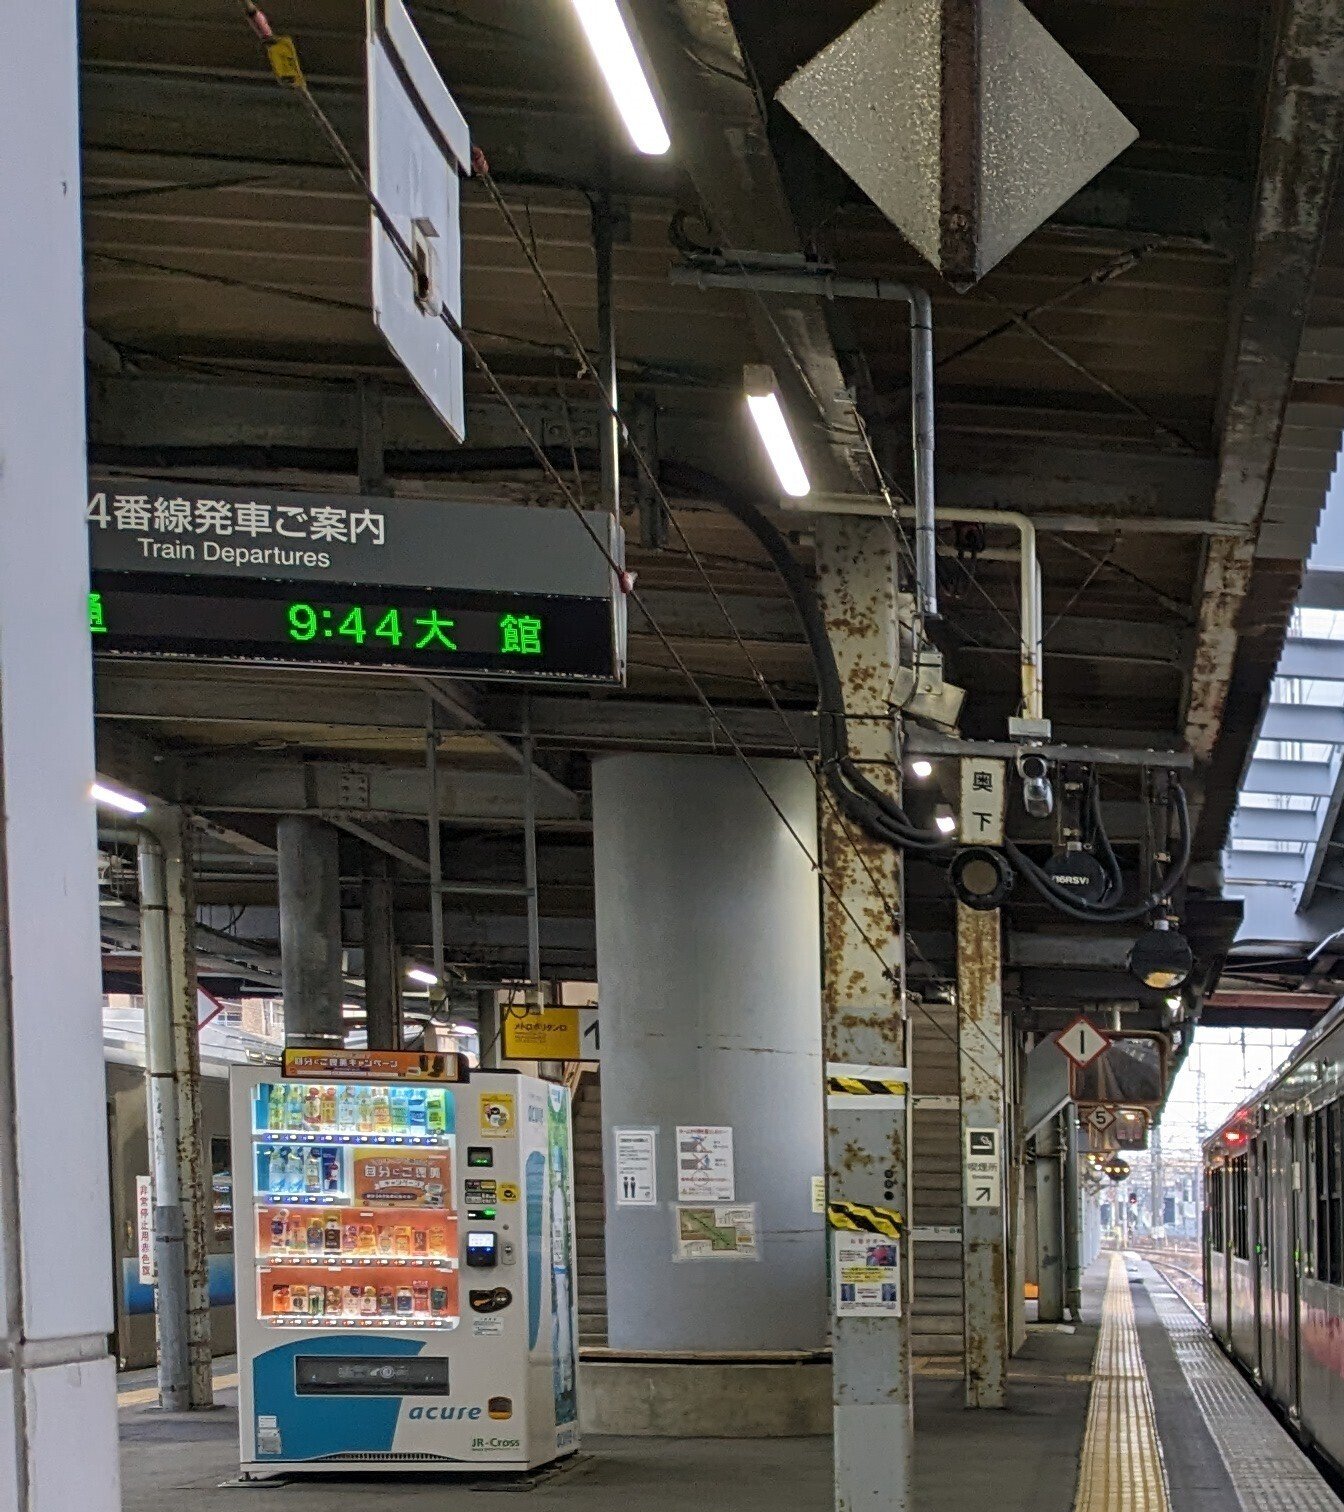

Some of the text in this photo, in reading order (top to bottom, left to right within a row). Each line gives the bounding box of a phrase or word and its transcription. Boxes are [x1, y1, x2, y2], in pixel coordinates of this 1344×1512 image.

[138, 538, 331, 568] Train Departures
[288, 603, 404, 647] 9:44
[1095, 1110, 1107, 1125] 5
[408, 1405, 482, 1420] acure
